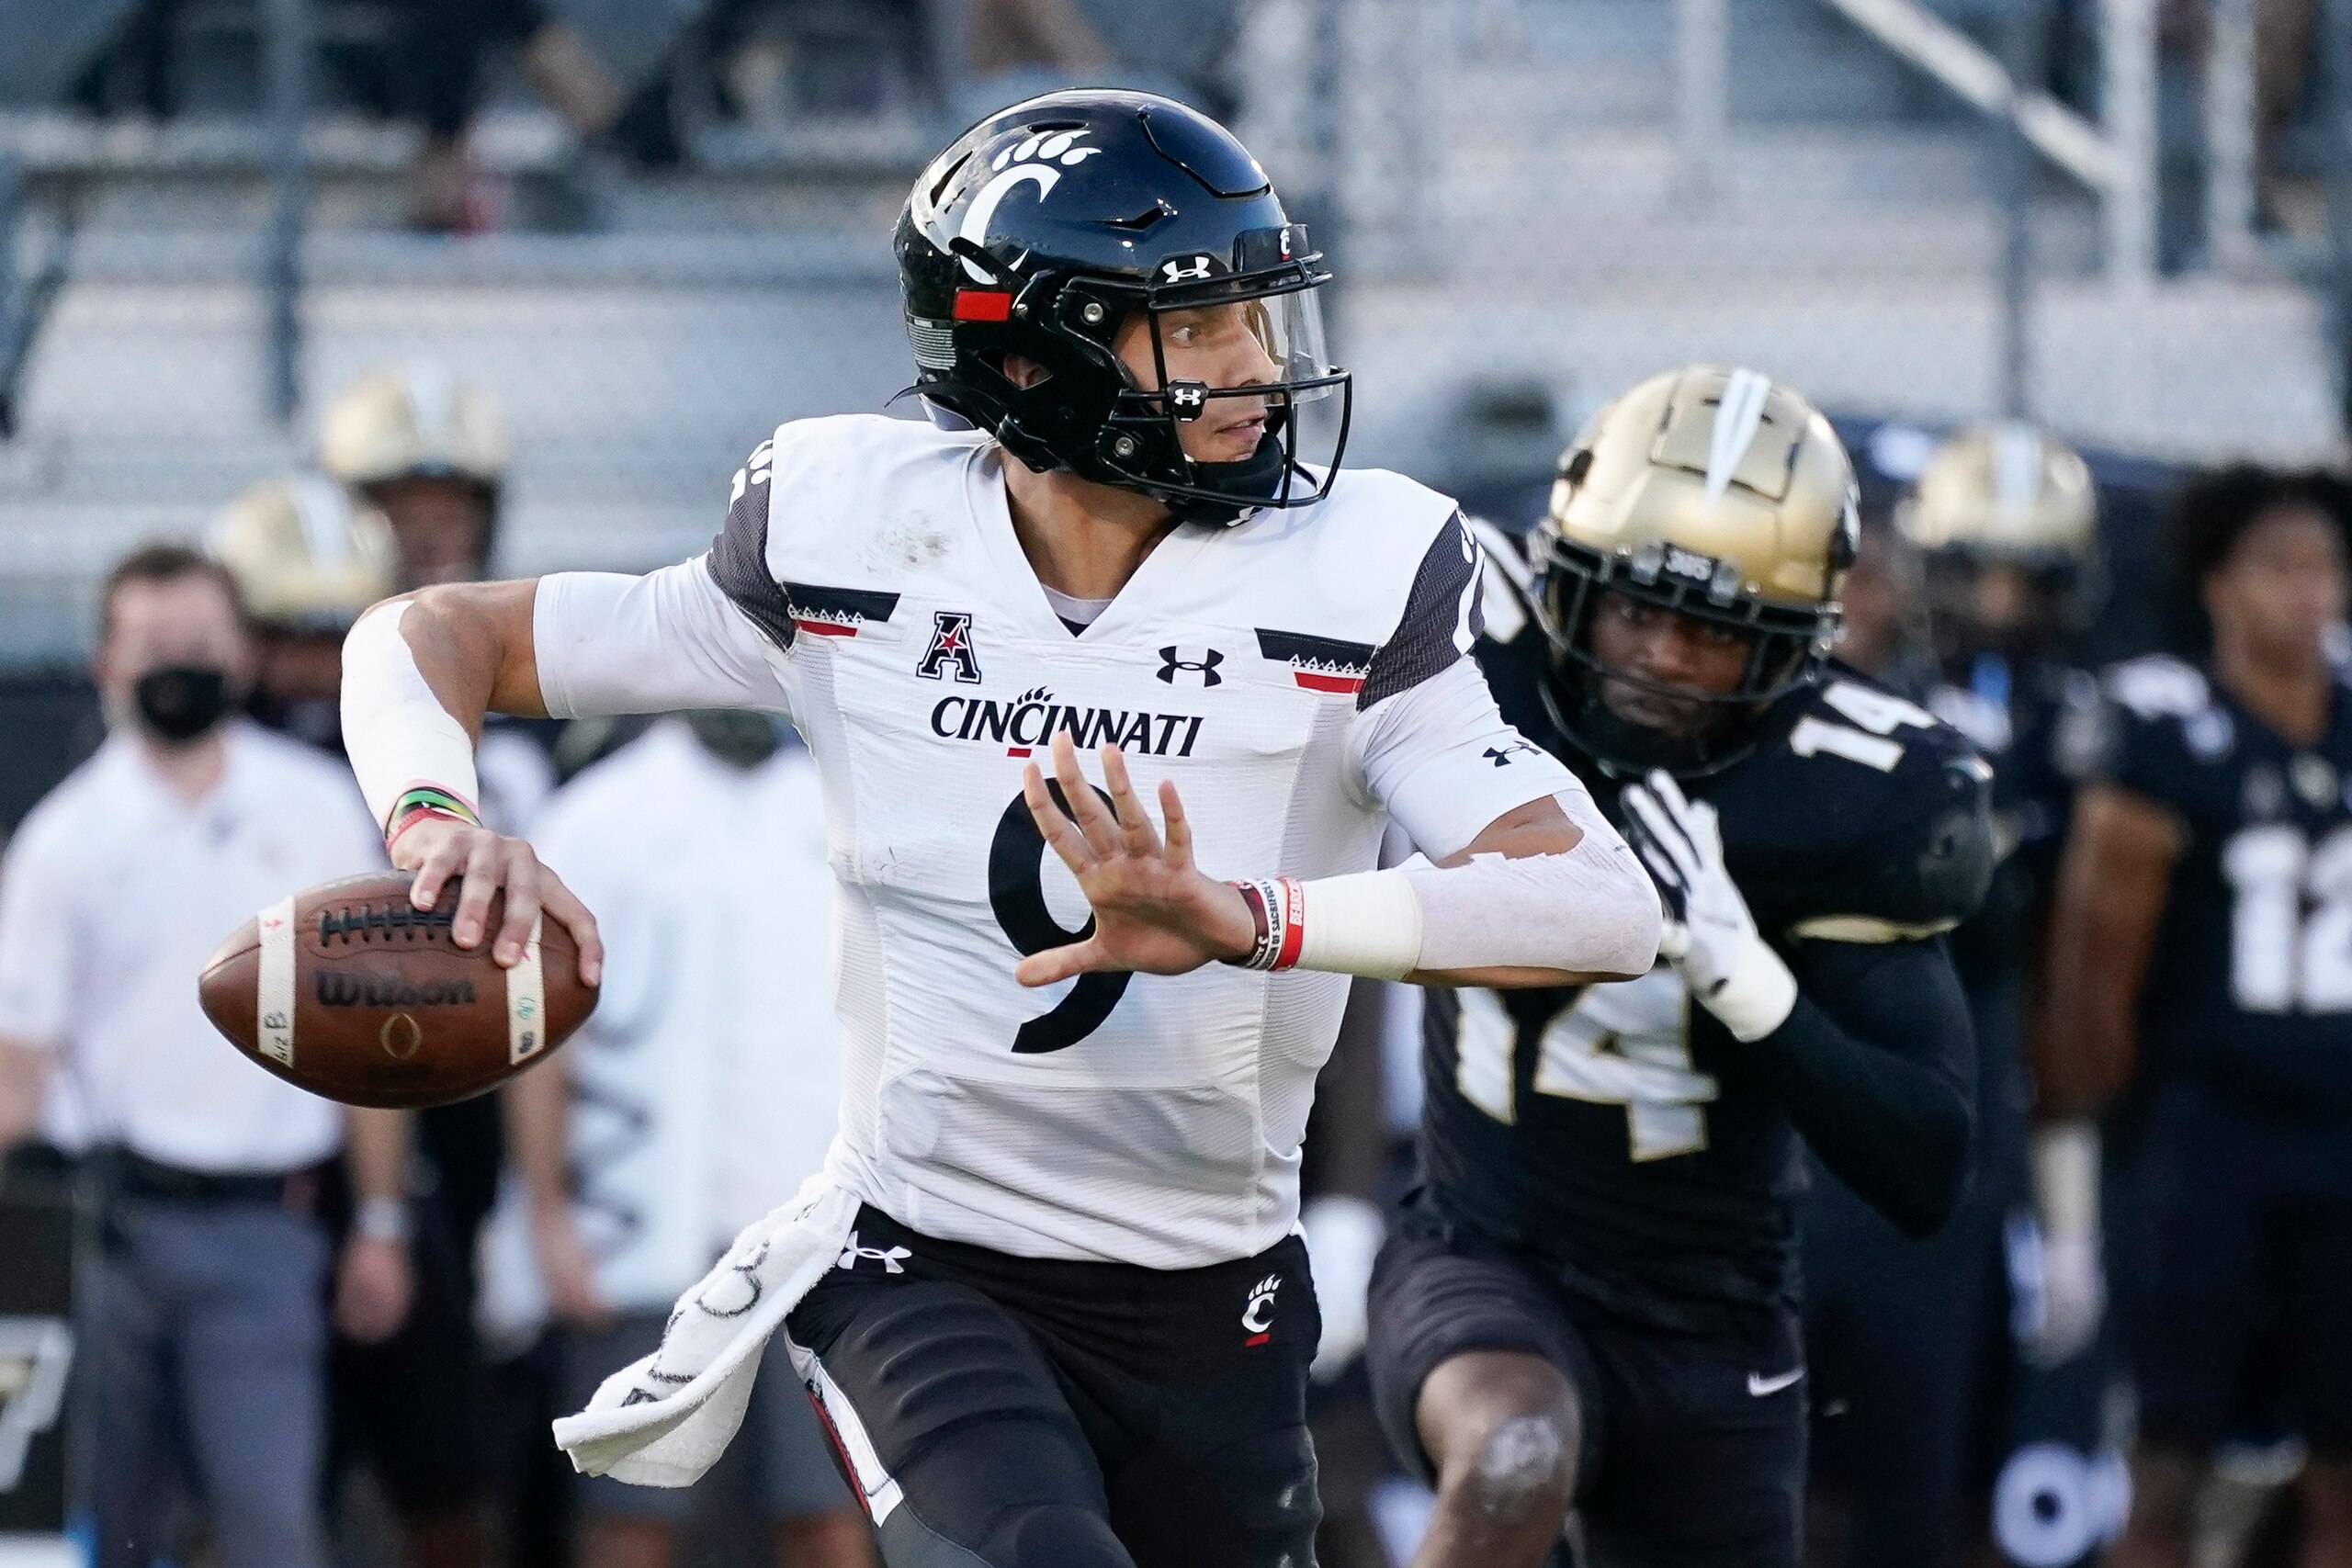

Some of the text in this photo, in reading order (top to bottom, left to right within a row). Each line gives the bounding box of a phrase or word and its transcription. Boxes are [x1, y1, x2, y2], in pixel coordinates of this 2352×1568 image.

[915, 611, 982, 685] A
[931, 694, 1205, 758] CINCINNATI
[1789, 678, 1936, 773] 14
[988, 777, 1136, 1055] 9
[1455, 970, 1721, 1164] 14
